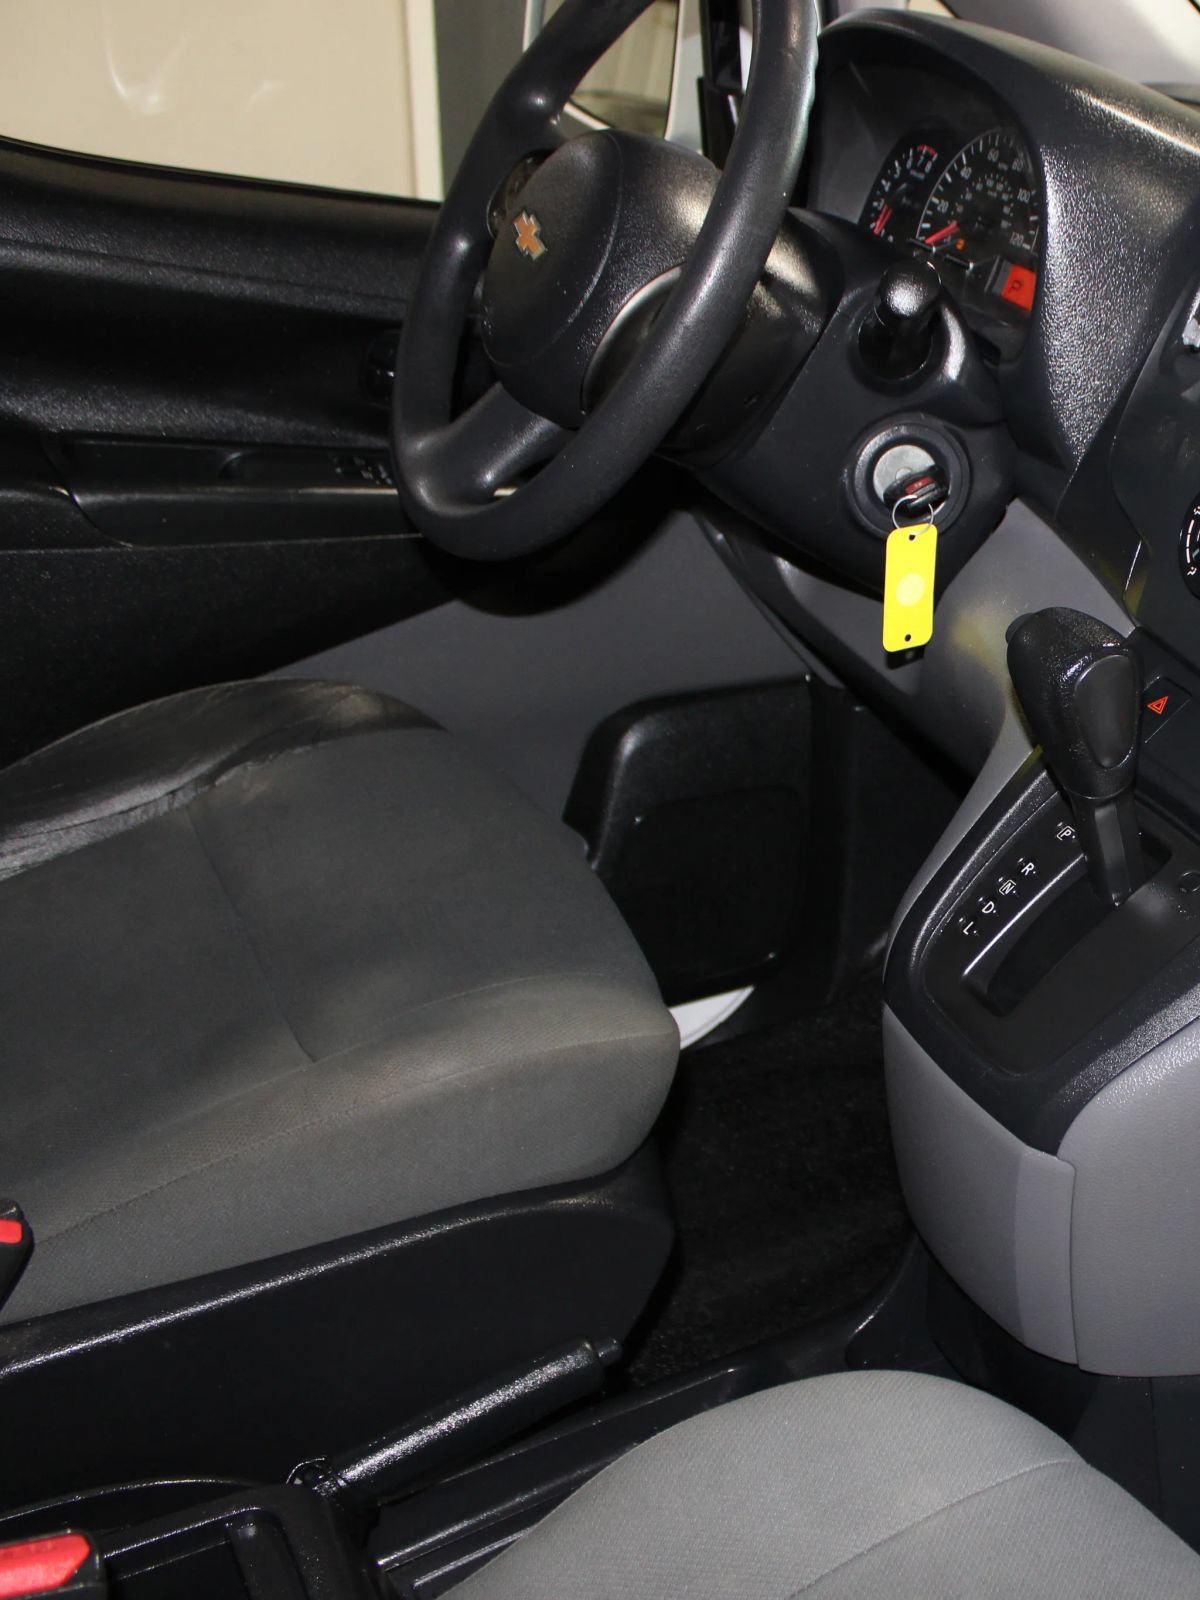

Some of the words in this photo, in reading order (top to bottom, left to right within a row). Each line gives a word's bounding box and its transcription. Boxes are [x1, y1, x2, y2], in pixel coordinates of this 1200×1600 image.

[1017, 188, 1031, 204] 100
[936, 199, 950, 213] 20
[1009, 231, 1025, 249] 120
[1008, 279, 1023, 293] P
[1020, 862, 1034, 876] R
[981, 901, 995, 914] D
[962, 921, 974, 935] L
